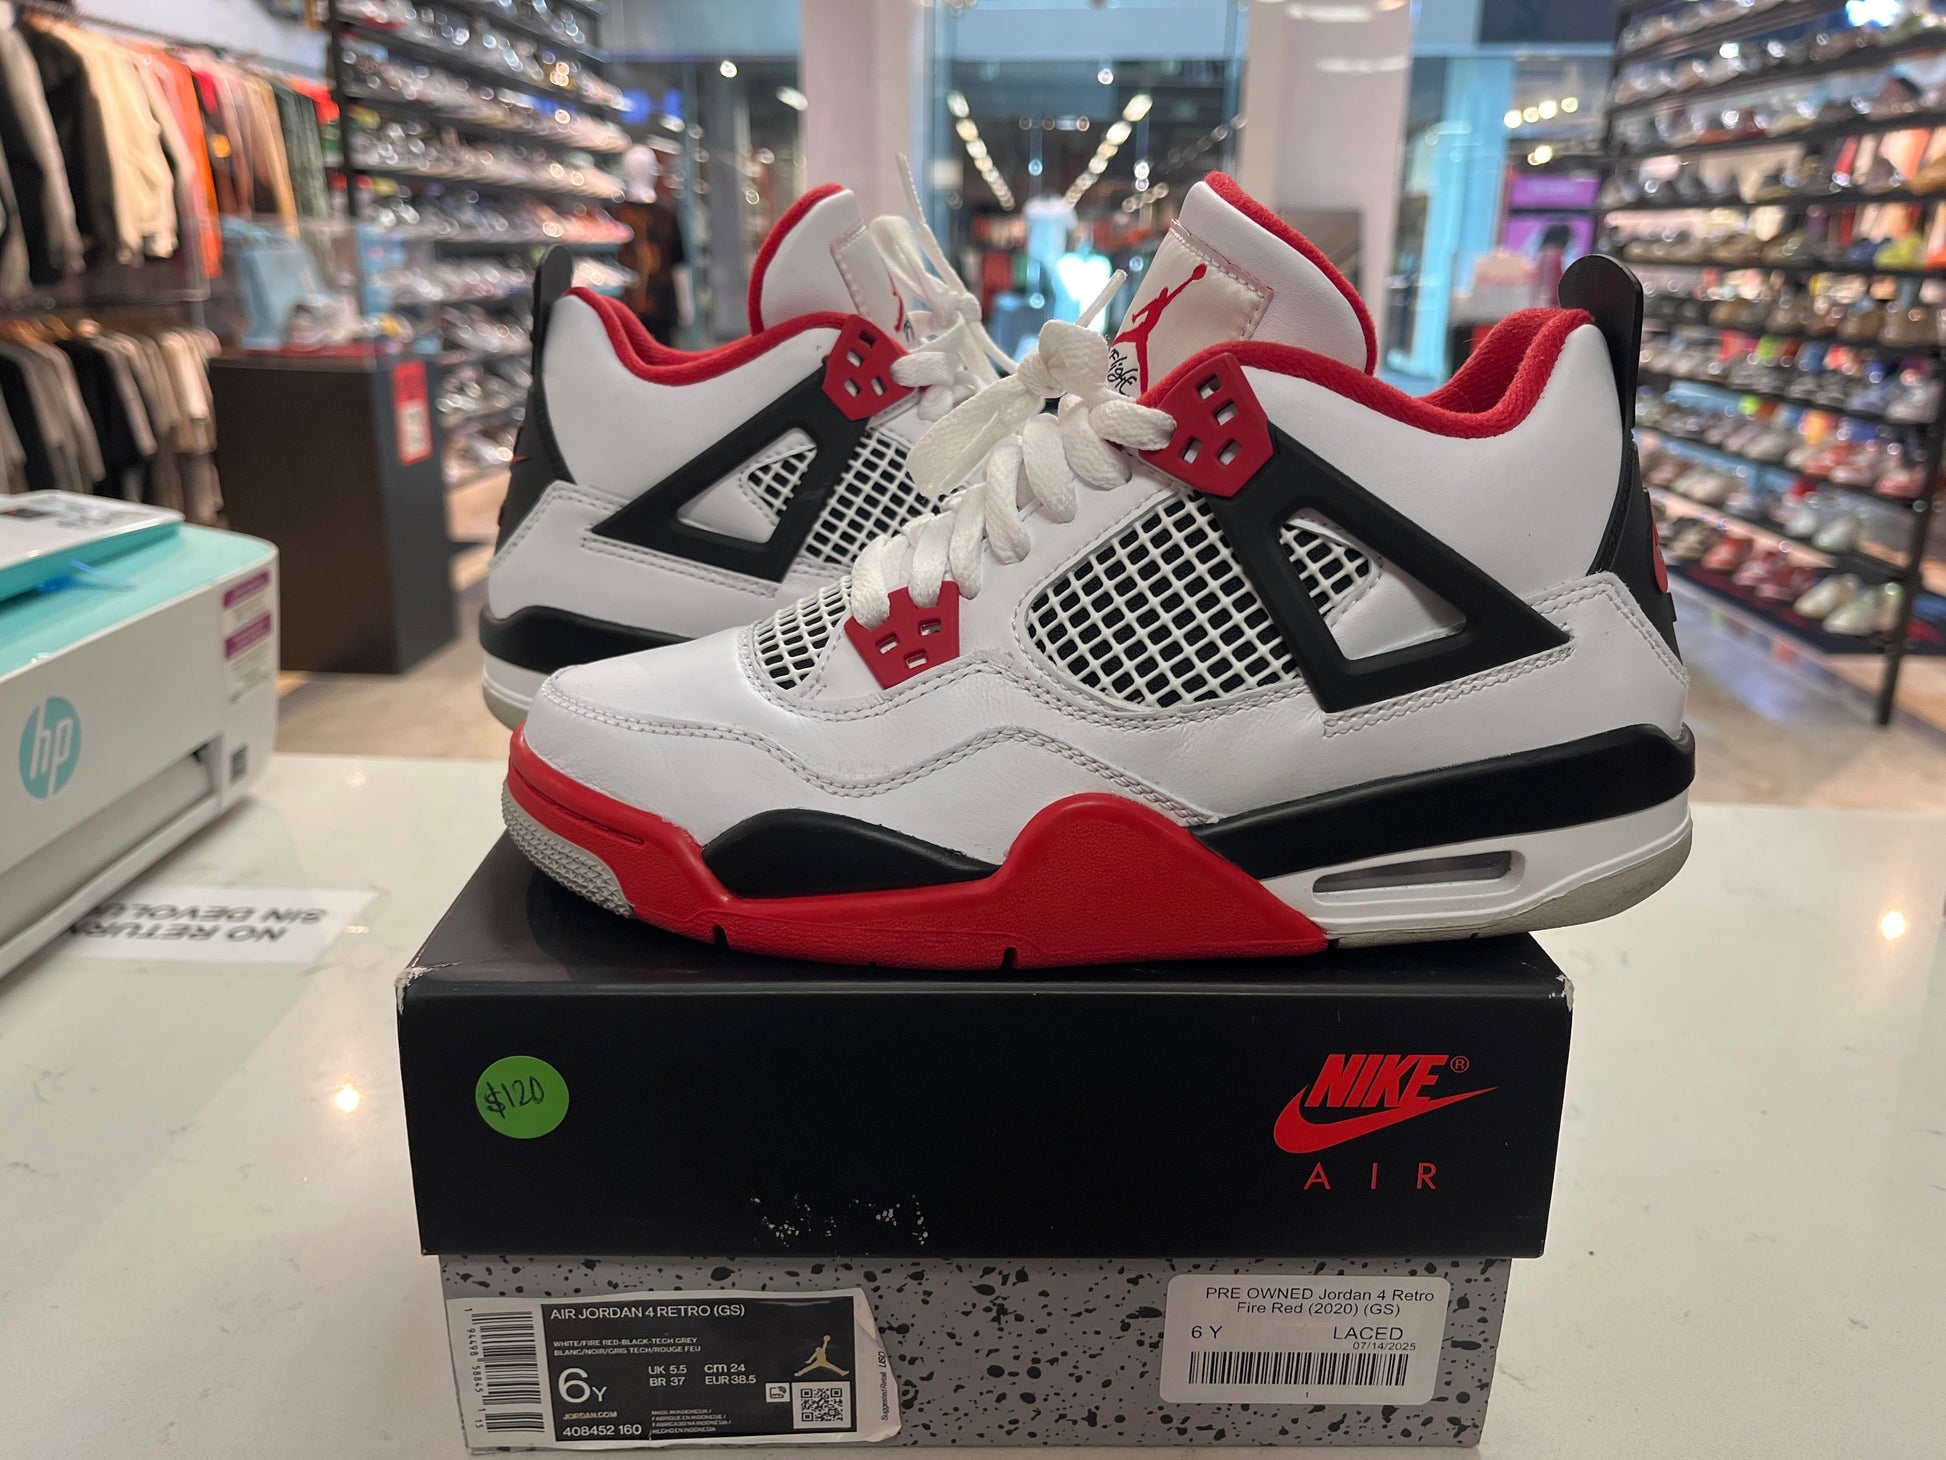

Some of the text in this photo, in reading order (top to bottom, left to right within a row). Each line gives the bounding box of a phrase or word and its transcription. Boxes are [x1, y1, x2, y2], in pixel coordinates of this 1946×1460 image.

[29, 697, 74, 798] hp
[262, 907, 327, 924] SIN
[227, 925, 286, 942] NO
[1304, 1053, 1449, 1108] NIKE
[484, 1075, 545, 1120] $120
[1303, 1161, 1437, 1190] AIR
[1205, 1287, 1434, 1302] PRE OWNED Jordan 4 Retro
[550, 1303, 745, 1320] AIR JORDAN 4 RETRO (GS)
[1236, 1301, 1401, 1317] Fire Red (2020) (GS)
[1190, 1325, 1223, 1339] 6 Y
[1333, 1326, 1404, 1340] LACED
[467, 1328, 479, 1357] 94498
[602, 1338, 673, 1346] RED-BLACK-TECH
[1352, 1341, 1416, 1351] 07/14/2025
[554, 1347, 628, 1356] BLANC/NOIR/GRIS
[630, 1346, 683, 1354] TECH/ROUGE
[648, 1363, 746, 1375] UK 5.5 cm 24
[649, 1375, 757, 1387] BR 37 EUR 38.5
[877, 1351, 889, 1421] Suggested Retail USD
[562, 1411, 618, 1420] JORDAN.COM
[562, 1424, 642, 1437] 408452 160
